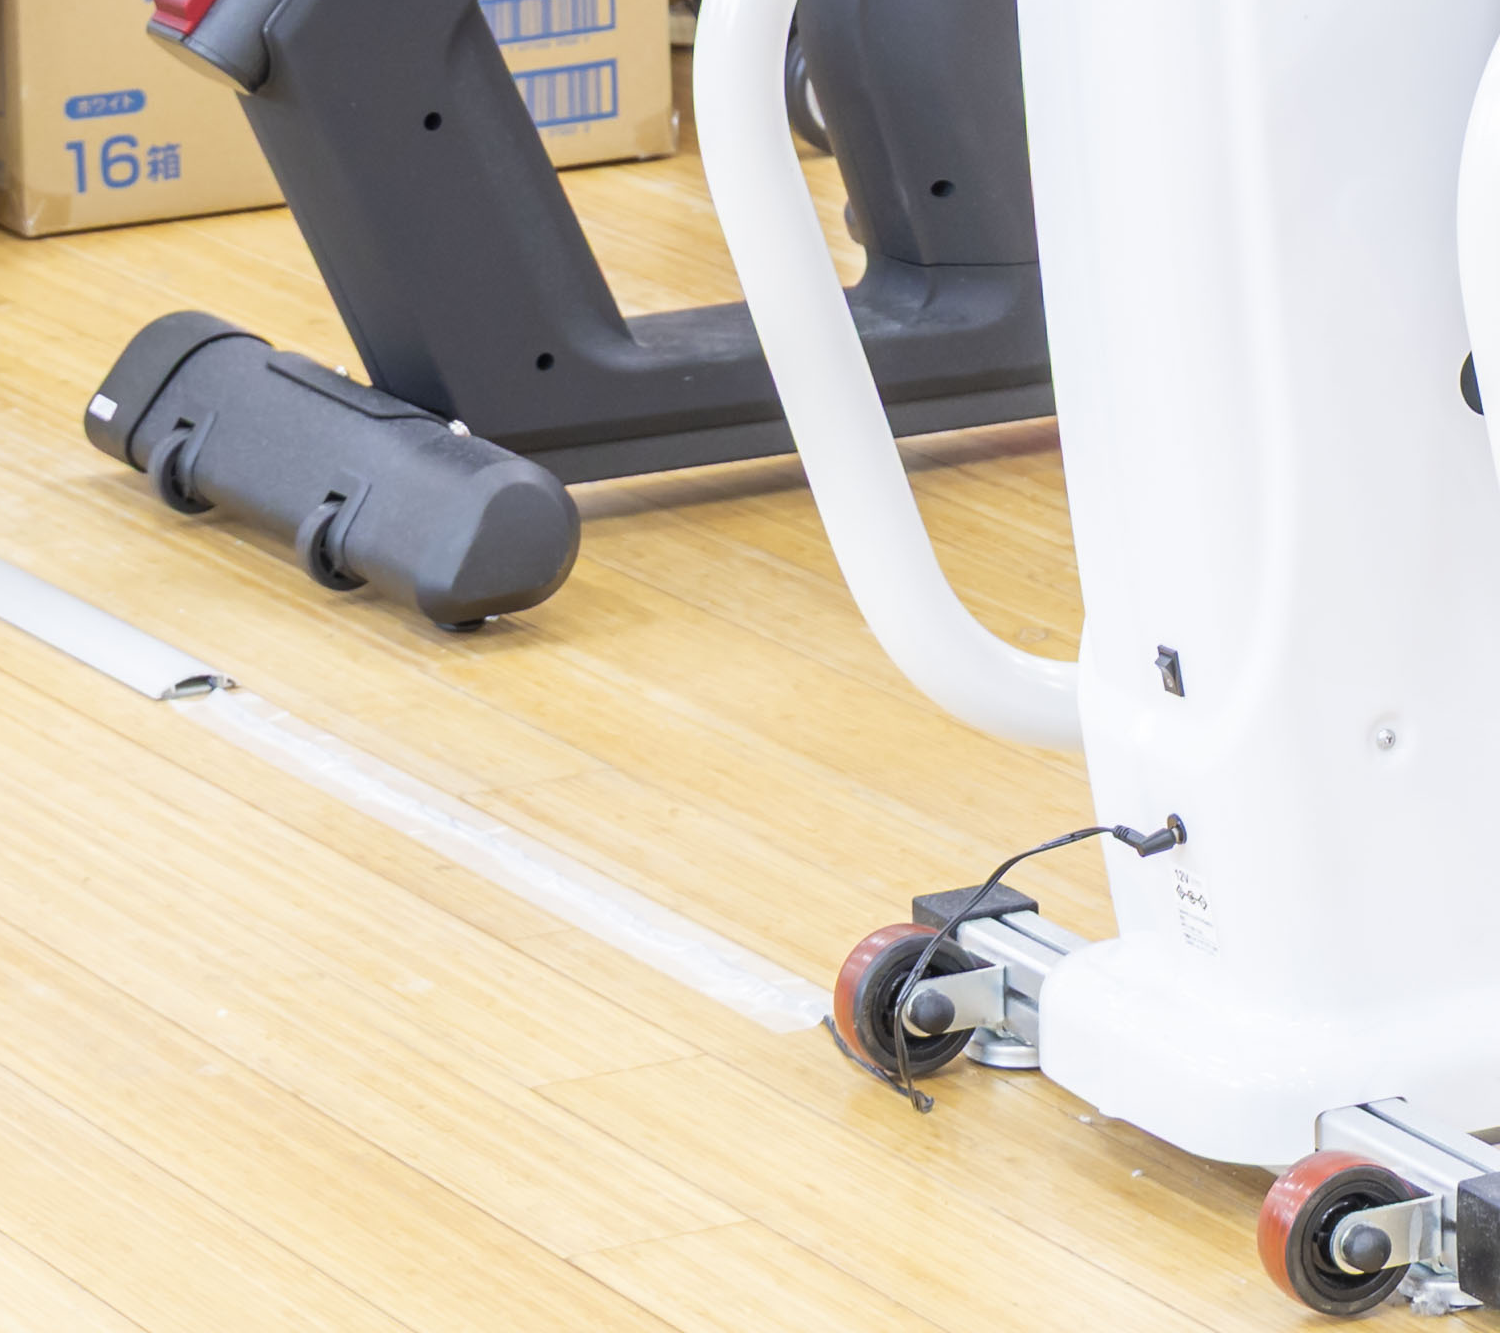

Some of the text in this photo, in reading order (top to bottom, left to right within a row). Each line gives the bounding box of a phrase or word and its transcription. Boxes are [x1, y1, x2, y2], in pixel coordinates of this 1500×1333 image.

[77, 93, 135, 115] ホワイト
[64, 133, 183, 195] 16箱
